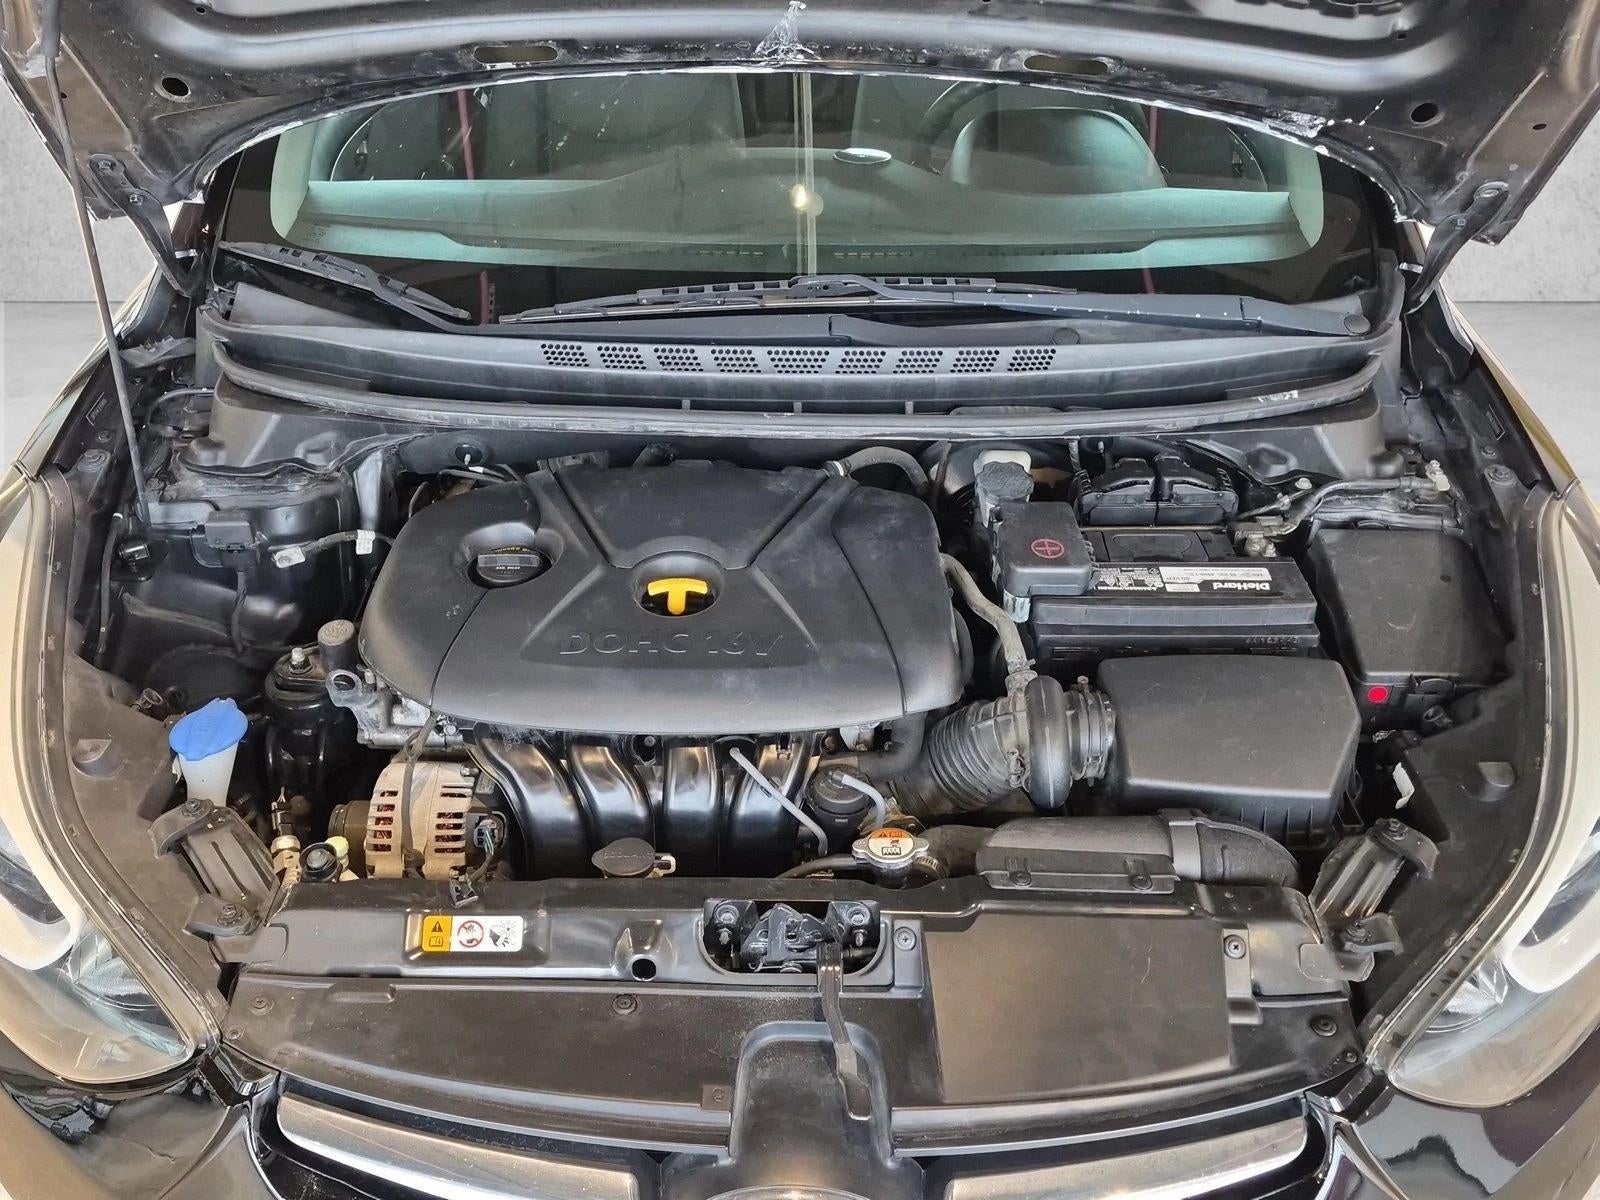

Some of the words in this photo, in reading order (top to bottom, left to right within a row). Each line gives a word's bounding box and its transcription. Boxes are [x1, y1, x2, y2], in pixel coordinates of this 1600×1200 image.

[1212, 582, 1271, 591] DieHard
[559, 632, 689, 654] DOHC
[705, 632, 784, 656] 16V
